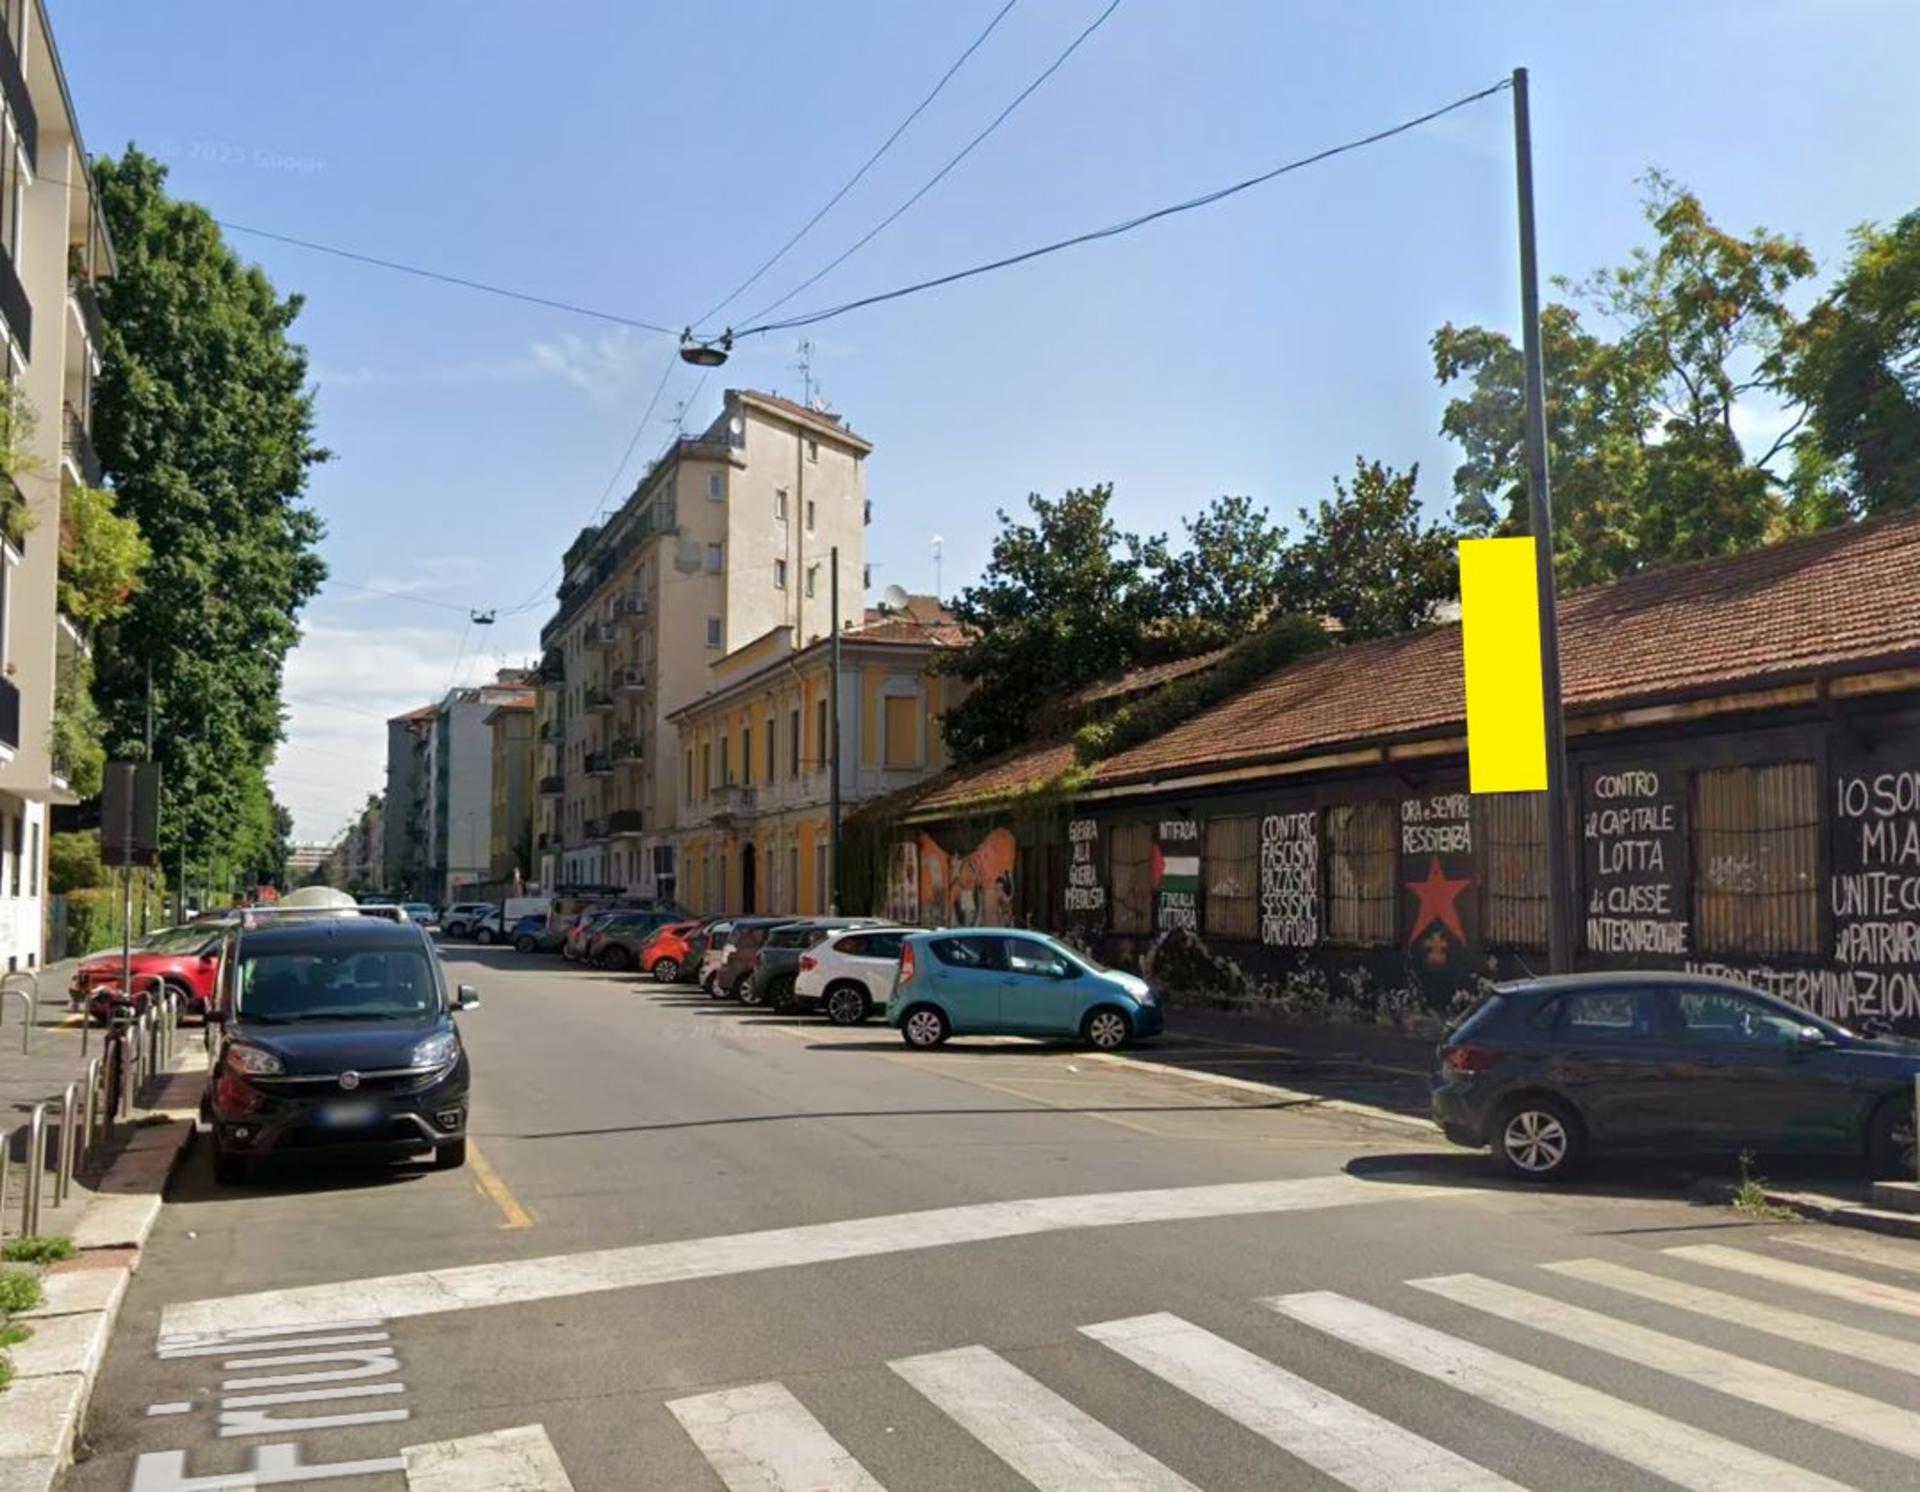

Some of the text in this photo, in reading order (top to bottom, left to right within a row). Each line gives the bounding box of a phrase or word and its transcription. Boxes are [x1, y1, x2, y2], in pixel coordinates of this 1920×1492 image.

[1594, 771, 1659, 799] CONTRO
[1837, 775, 1870, 819] IO
[1261, 811, 1318, 842] CONTRO
[1401, 799, 1422, 823] ORA
[1599, 804, 1676, 836] CAPITALE
[1402, 820, 1472, 855] RESISTENZA
[1862, 820, 1920, 865] MIA
[1598, 838, 1665, 875] LOTTA
[1607, 884, 1673, 914] CLASSE
